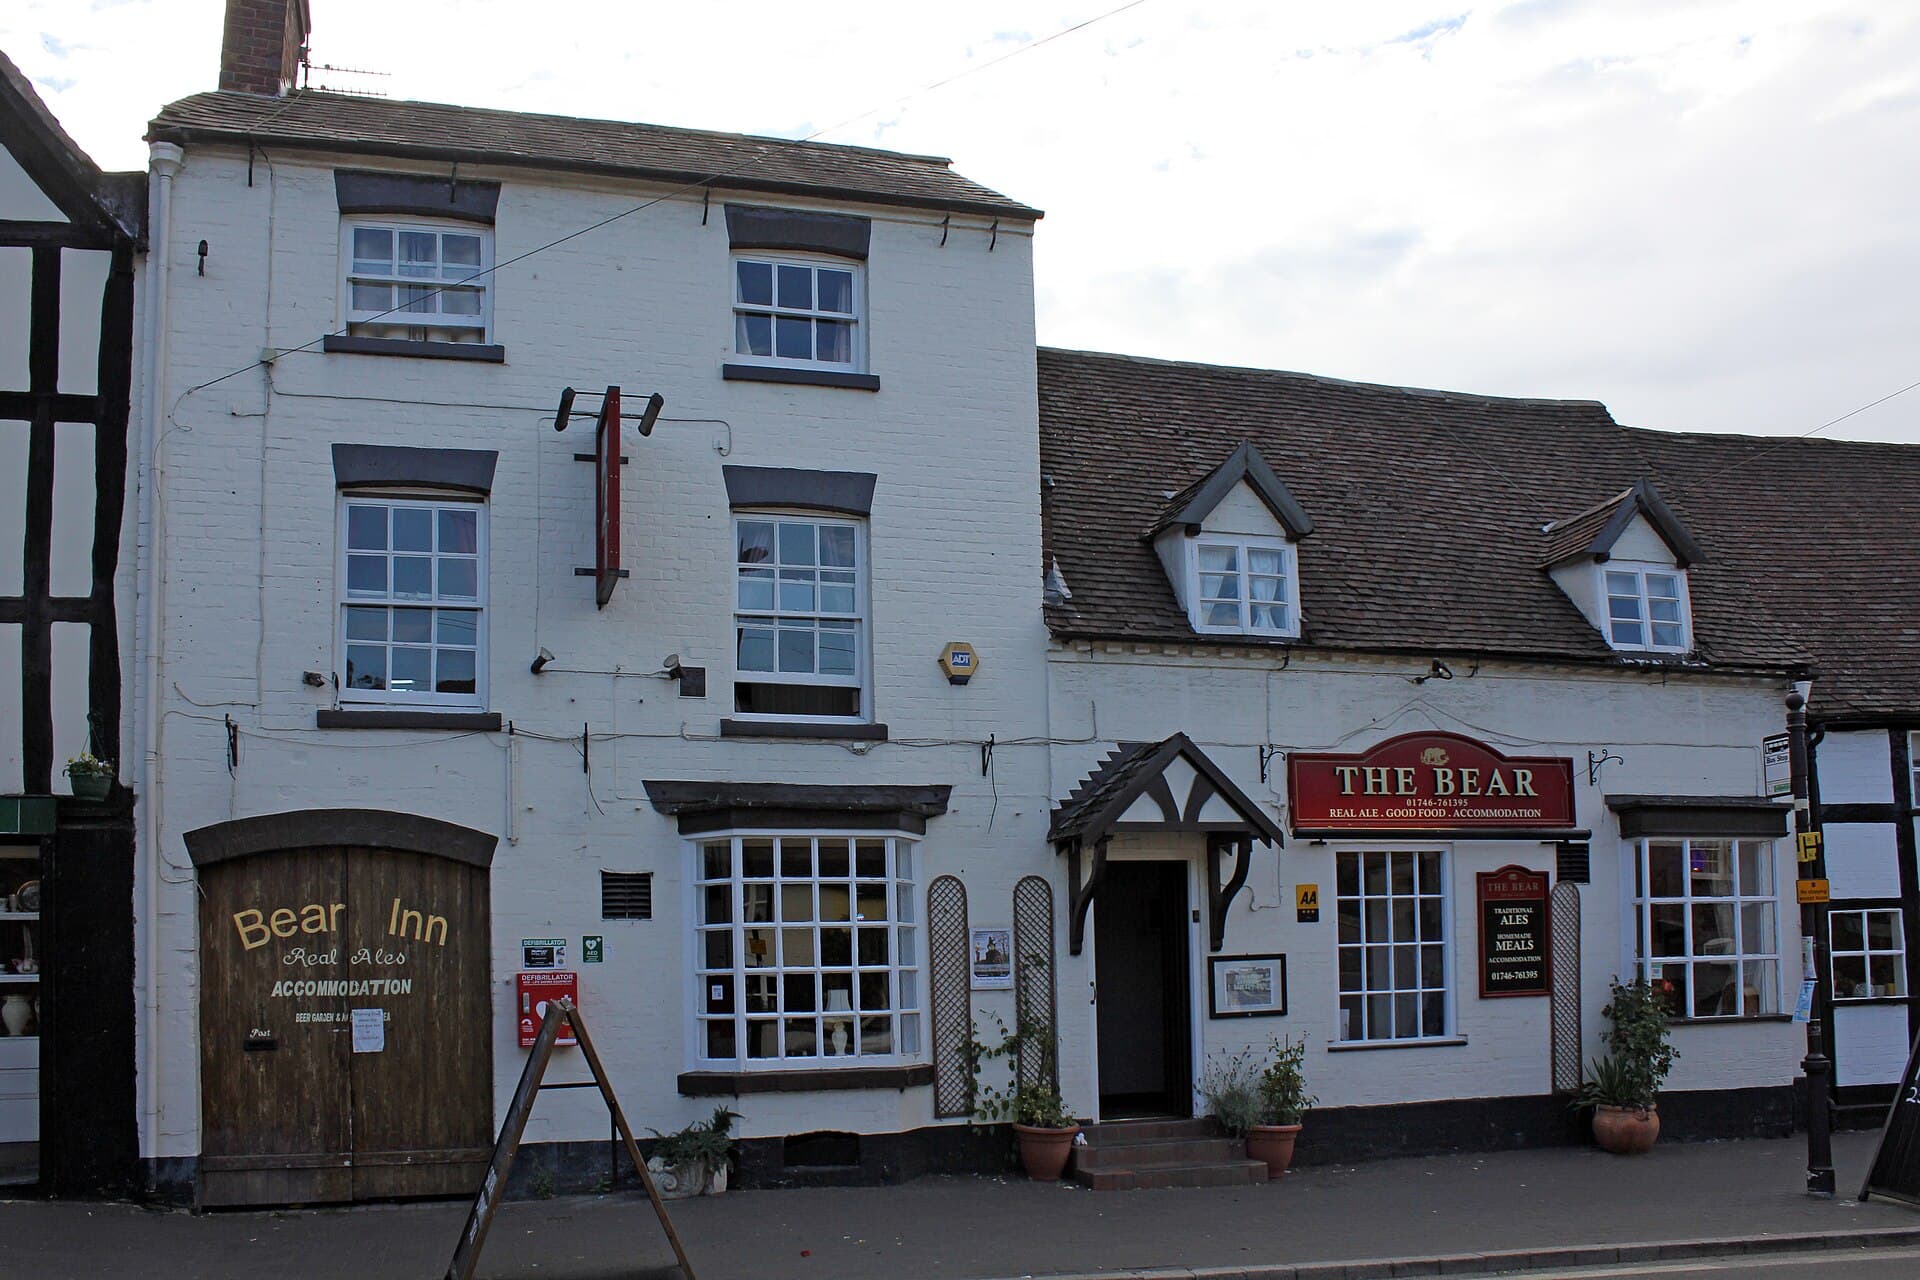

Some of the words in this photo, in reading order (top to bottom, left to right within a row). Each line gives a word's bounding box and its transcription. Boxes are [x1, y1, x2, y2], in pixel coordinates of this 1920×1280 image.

[953, 654, 970, 664] ADT
[1766, 756, 1776, 764] Bus
[1335, 766, 1417, 795] THE
[1432, 767, 1538, 796] BEAR
[1406, 798, 1468, 807] 01746-761395
[1329, 808, 1357, 818] REAL
[1359, 808, 1378, 817] ALE
[1386, 808, 1416, 817] GOOD
[1418, 808, 1446, 817] FOOD
[1453, 808, 1541, 817] ACCOMMODATION
[1487, 883, 1509, 892] THE
[1512, 882, 1539, 891] BEAR
[1300, 891, 1316, 904] AA
[233, 903, 346, 951] Bear
[388, 898, 448, 946] Inn
[1500, 914, 1528, 925] ALES
[1496, 940, 1534, 951] MEALS
[283, 947, 337, 968] Real
[351, 948, 406, 965] Ales
[1491, 970, 1538, 981] 01746-761395
[271, 979, 411, 997] ACCOMMODATION
[295, 1012, 311, 1022] BEER
[312, 1012, 334, 1022] GARDEN
[335, 1012, 341, 1022] &
